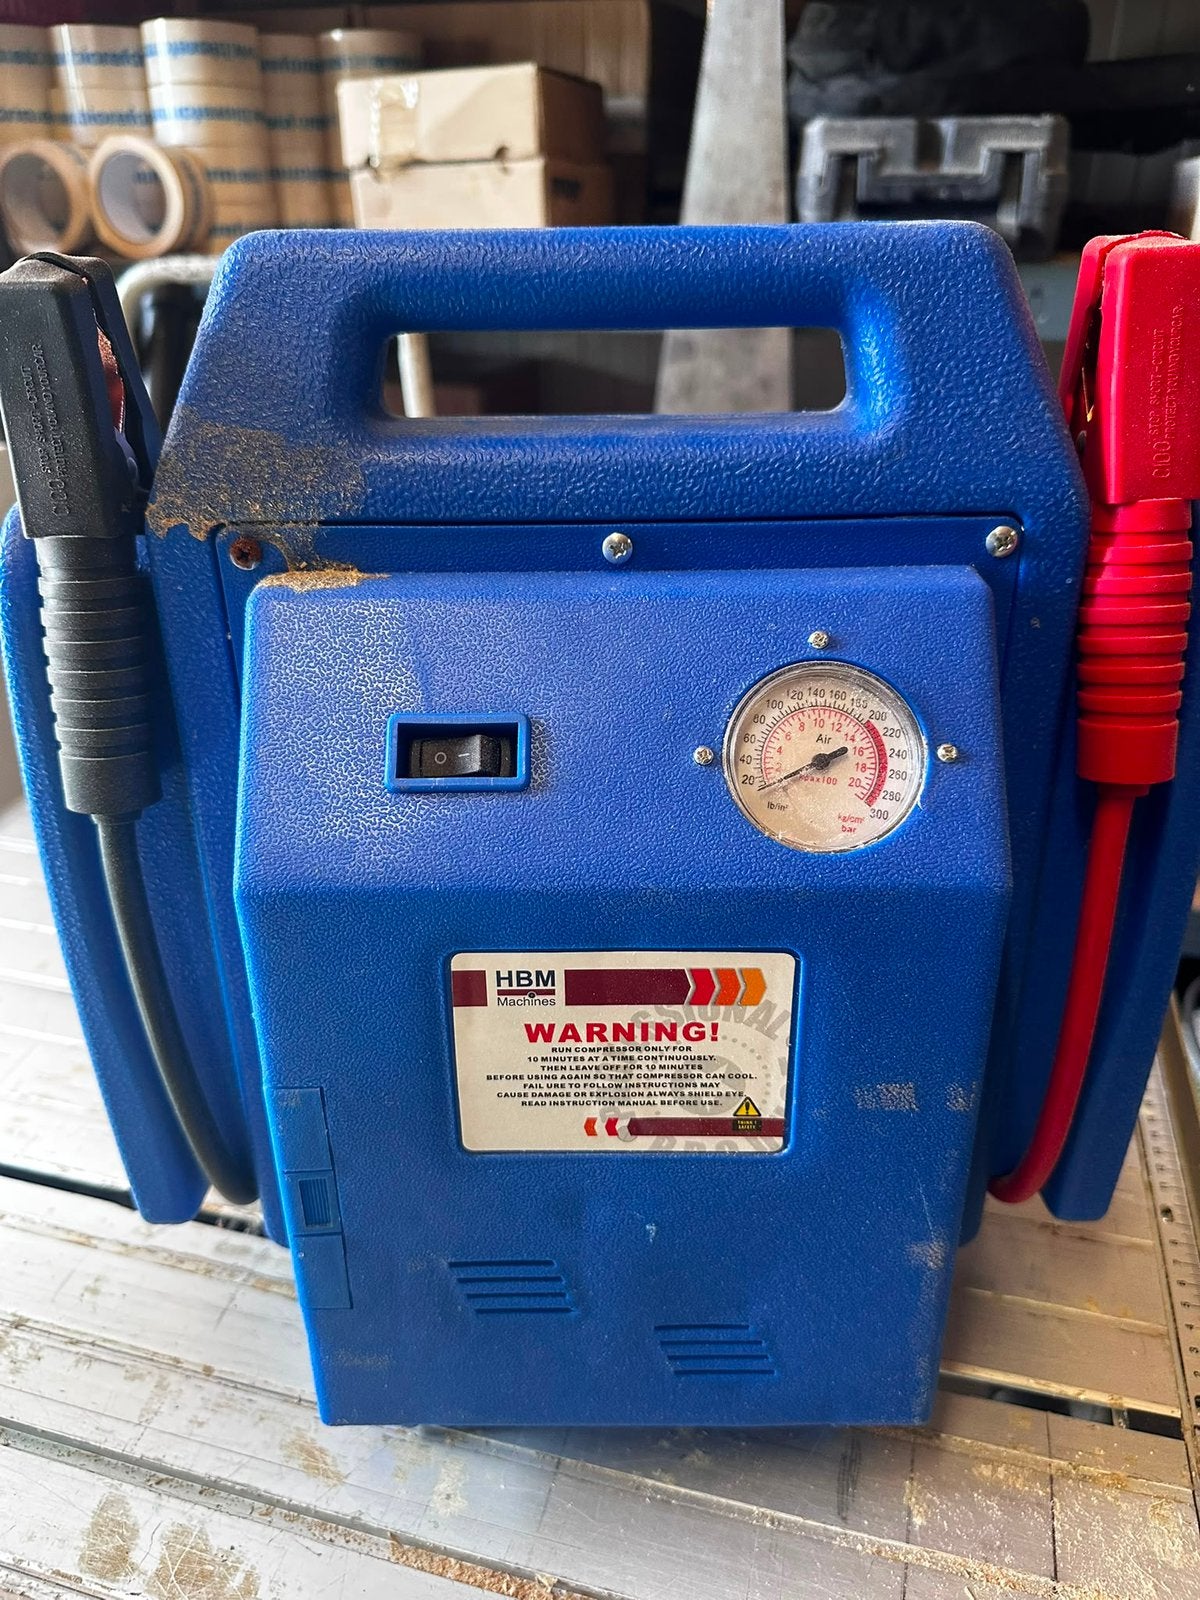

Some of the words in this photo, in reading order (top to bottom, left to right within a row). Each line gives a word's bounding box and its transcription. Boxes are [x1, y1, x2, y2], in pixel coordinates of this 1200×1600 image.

[787, 689, 803, 700] 120
[808, 687, 825, 698] 140
[829, 690, 847, 700] 160
[766, 699, 784, 710] 100
[753, 714, 766, 724] 80
[869, 710, 887, 721] 200
[799, 722, 805, 732] 8
[813, 718, 825, 729] 10
[831, 722, 842, 733] 12
[744, 734, 756, 743] 60
[785, 732, 791, 741] 6
[844, 733, 855, 743] 14
[883, 727, 901, 739] 220
[816, 734, 832, 744] Air
[777, 746, 783, 755] 4
[853, 746, 864, 757] 16
[889, 748, 907, 760] 240
[740, 755, 752, 765] 40
[855, 762, 867, 773] 18
[742, 775, 755, 785] 20
[889, 769, 907, 781] 260
[849, 777, 862, 788] 20
[882, 790, 901, 802] 280
[870, 808, 889, 820] 300
[841, 824, 856, 833] bar
[495, 970, 555, 987] HBM
[497, 997, 556, 1007] Machines
[524, 1022, 720, 1043] WARNING!
